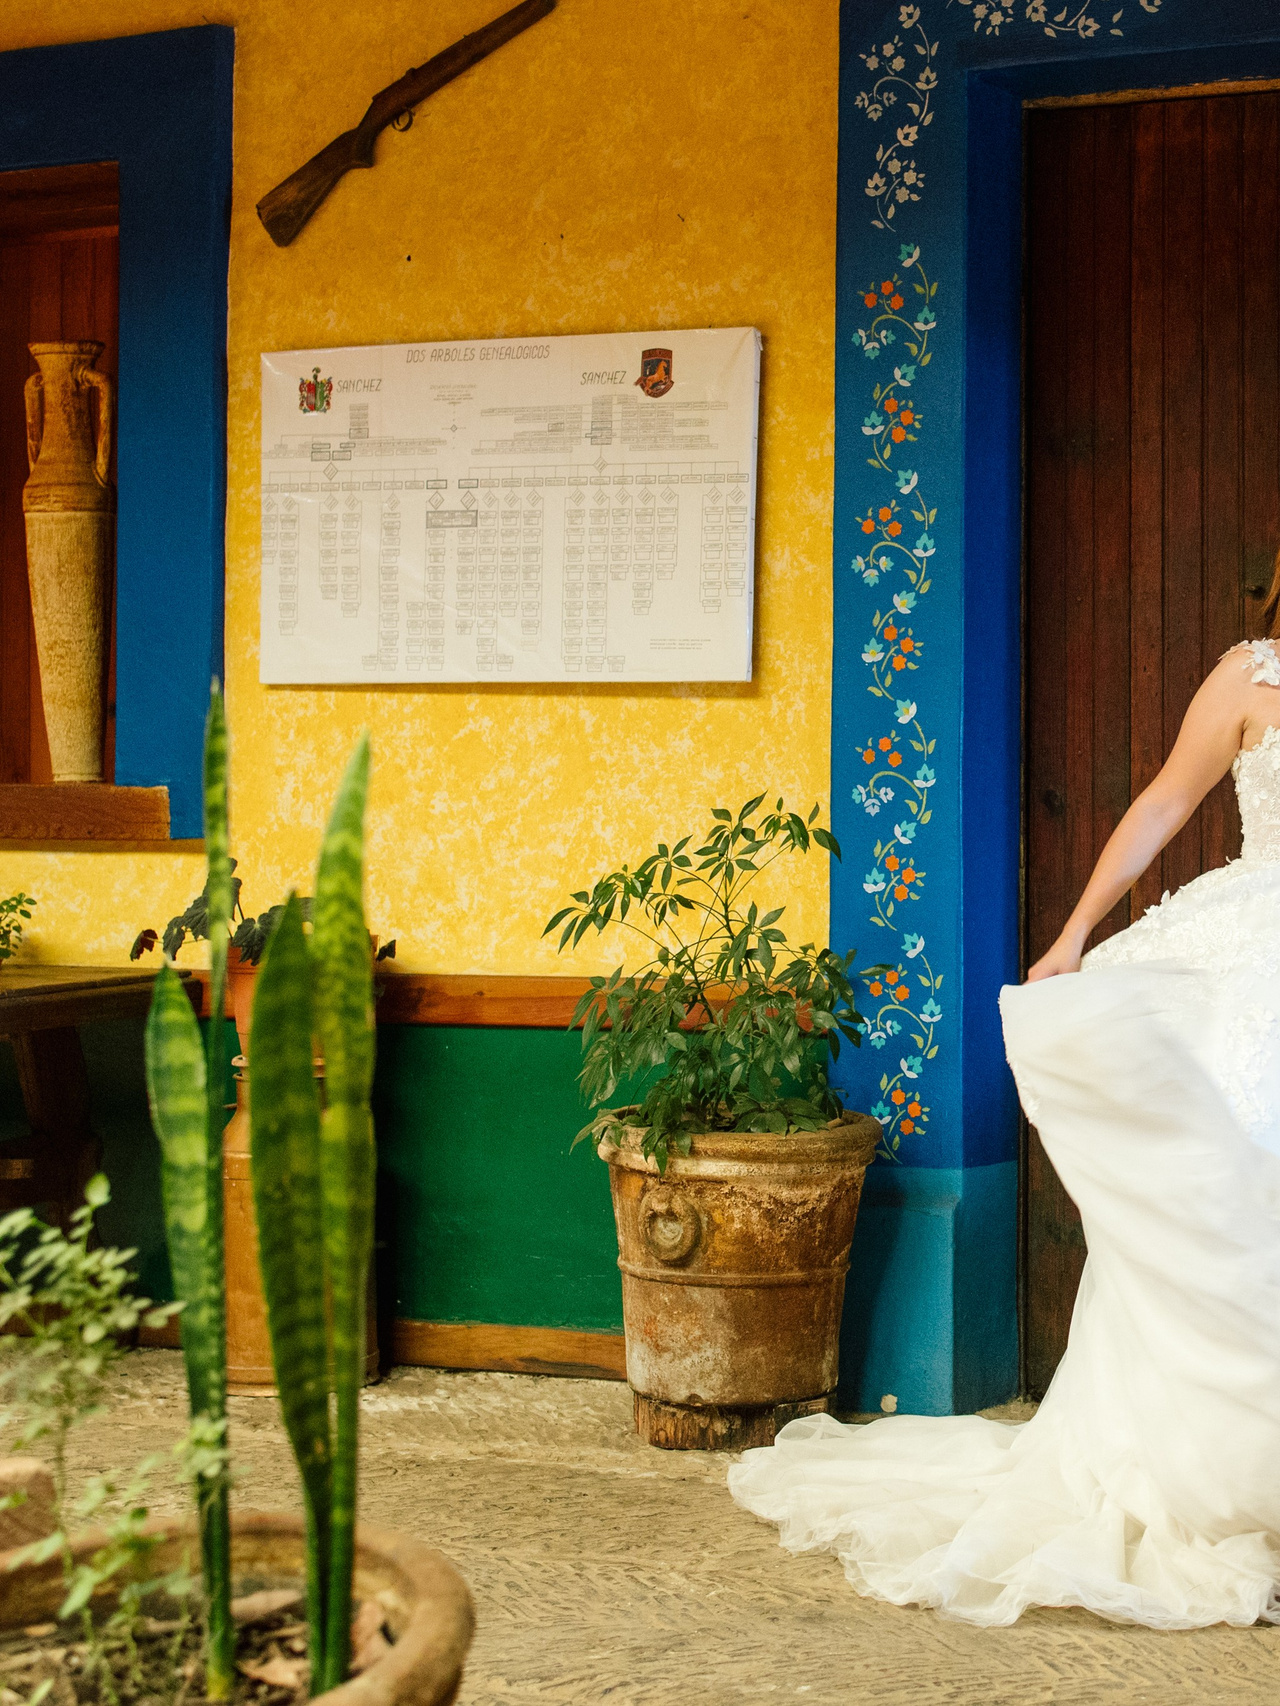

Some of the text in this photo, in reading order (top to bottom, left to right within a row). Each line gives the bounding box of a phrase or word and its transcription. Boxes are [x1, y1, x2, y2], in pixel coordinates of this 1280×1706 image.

[406, 345, 550, 363] DOS ARBOLES GENEALOGICOS
[580, 371, 627, 385] SANCHEZ
[336, 379, 383, 394] SANCHEZ
